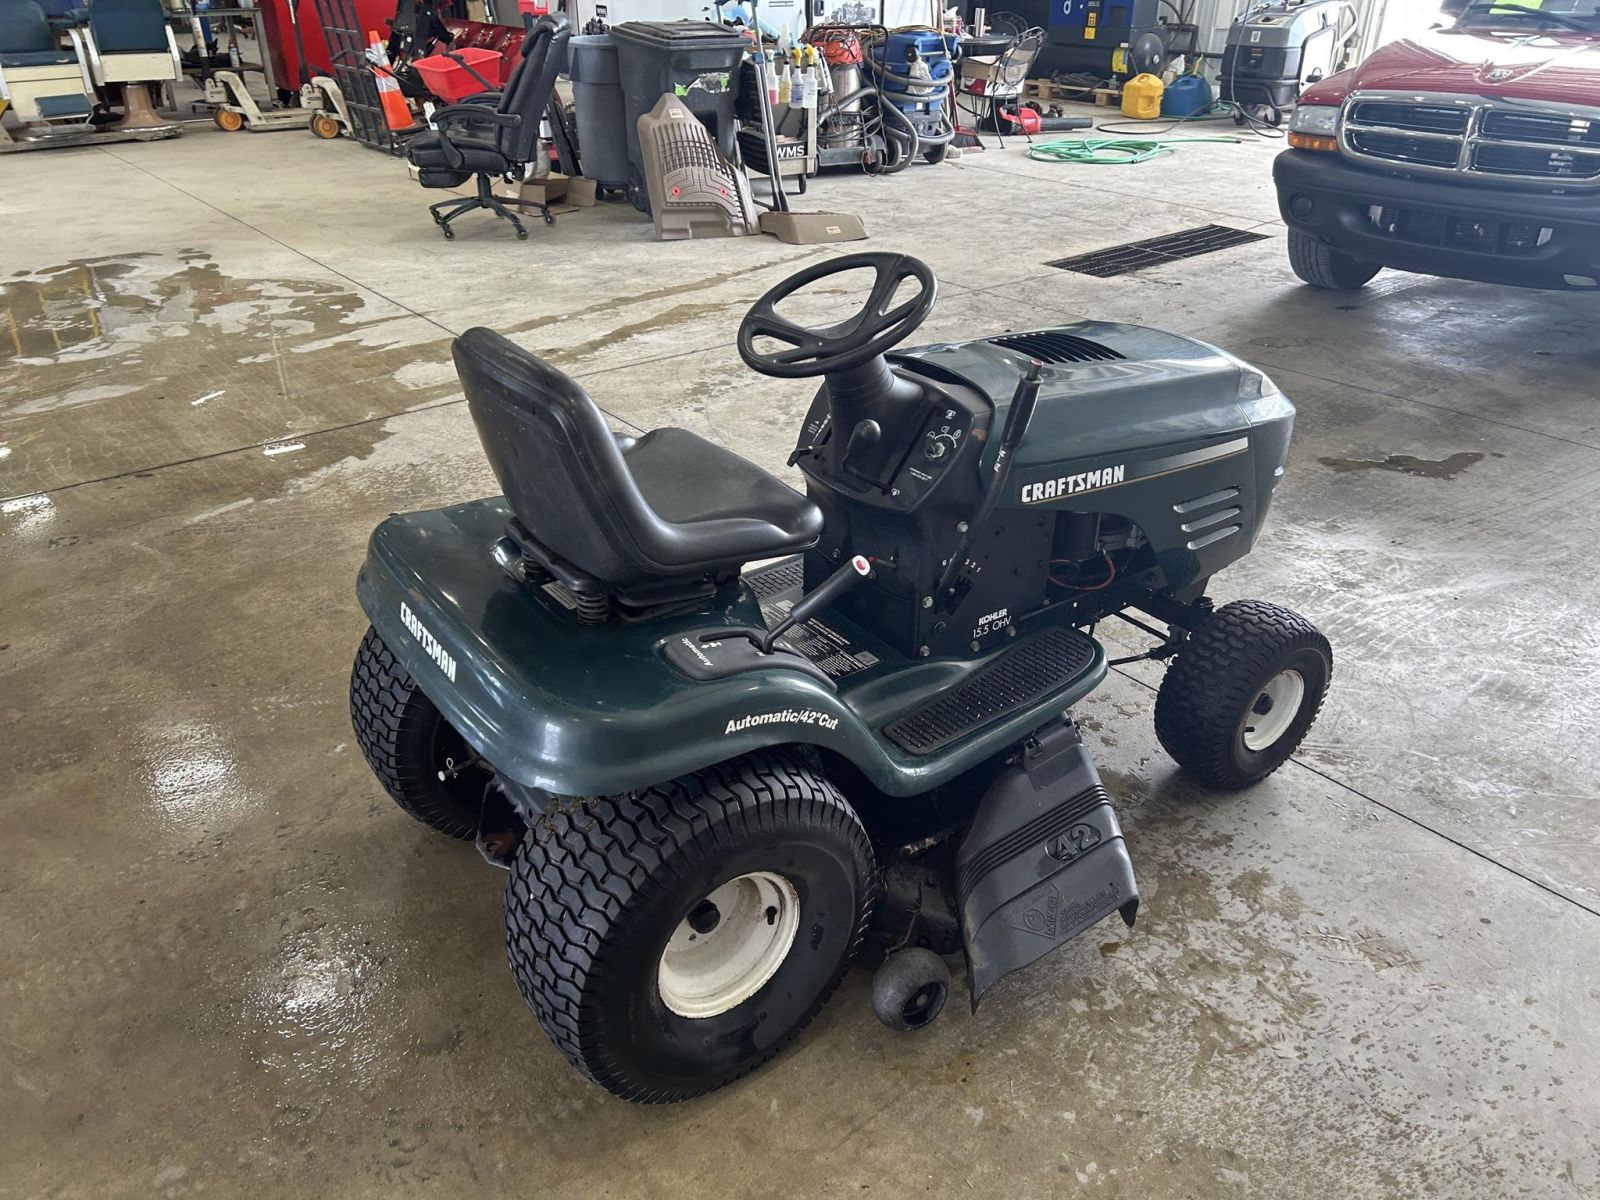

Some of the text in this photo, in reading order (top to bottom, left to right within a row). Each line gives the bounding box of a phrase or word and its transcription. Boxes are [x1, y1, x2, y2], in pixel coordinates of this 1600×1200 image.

[777, 145, 805, 158] WMS
[1021, 465, 1125, 503] CRAFTSMAN
[979, 608, 1007, 626] KOHLER
[992, 615, 1011, 631] OHV
[400, 601, 456, 683] CRAFTSMAN
[1056, 824, 1099, 857] 42
